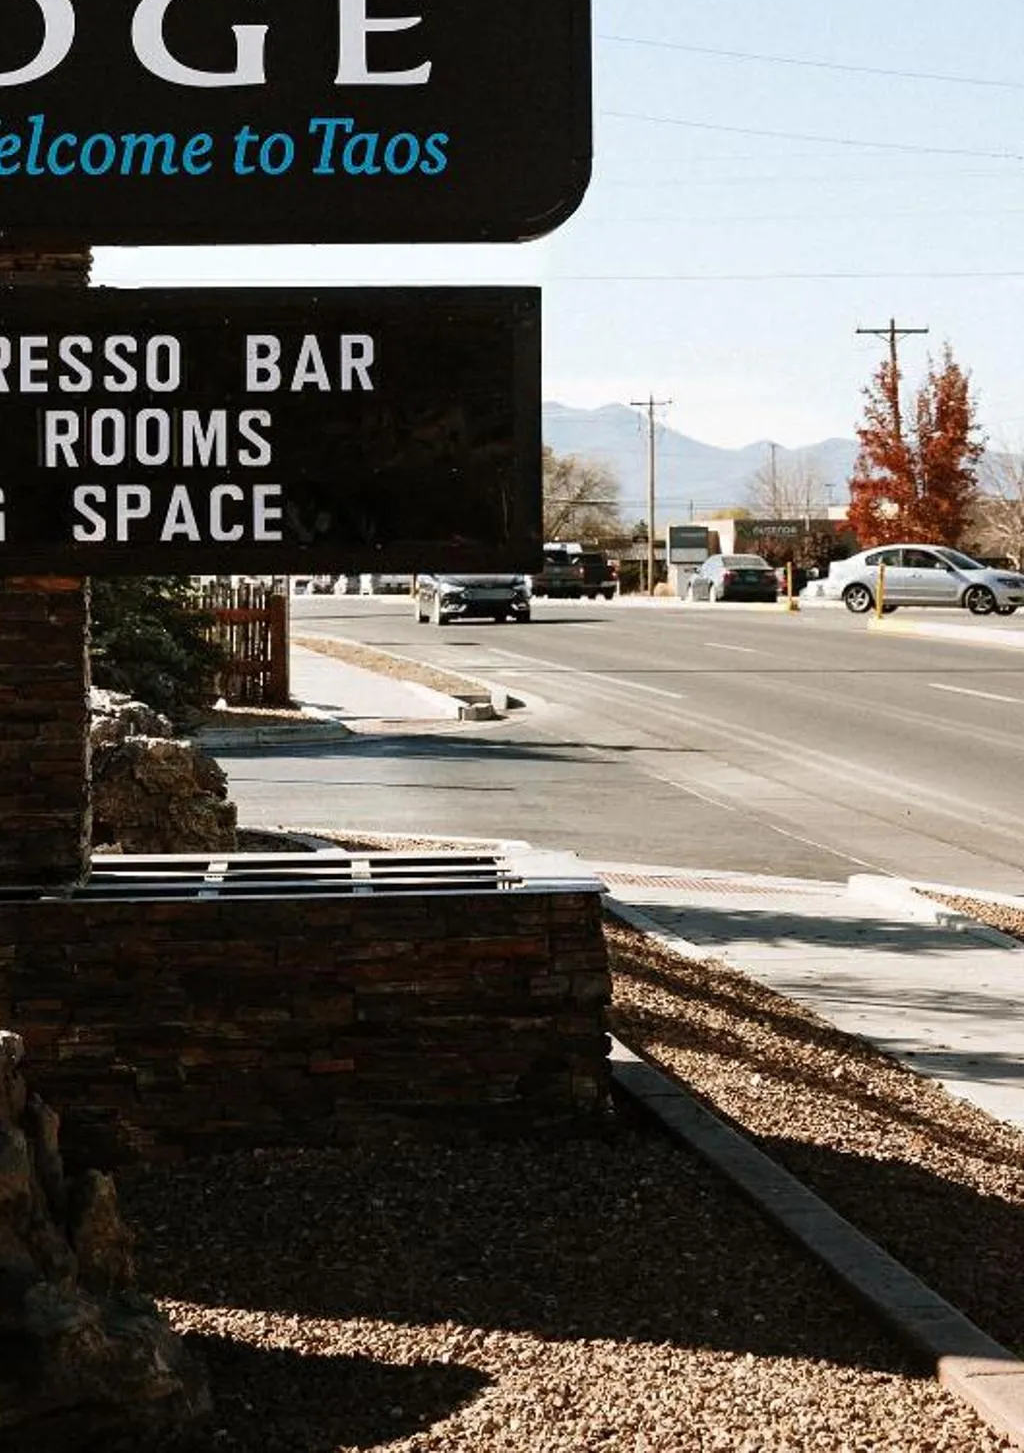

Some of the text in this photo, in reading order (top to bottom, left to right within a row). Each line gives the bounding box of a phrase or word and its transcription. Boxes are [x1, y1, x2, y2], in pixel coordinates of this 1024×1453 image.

[234, 125, 295, 175] to
[308, 117, 449, 175] Taos
[246, 334, 375, 392] BAR
[45, 408, 272, 468] ROOMS
[73, 484, 283, 542] SPACE
